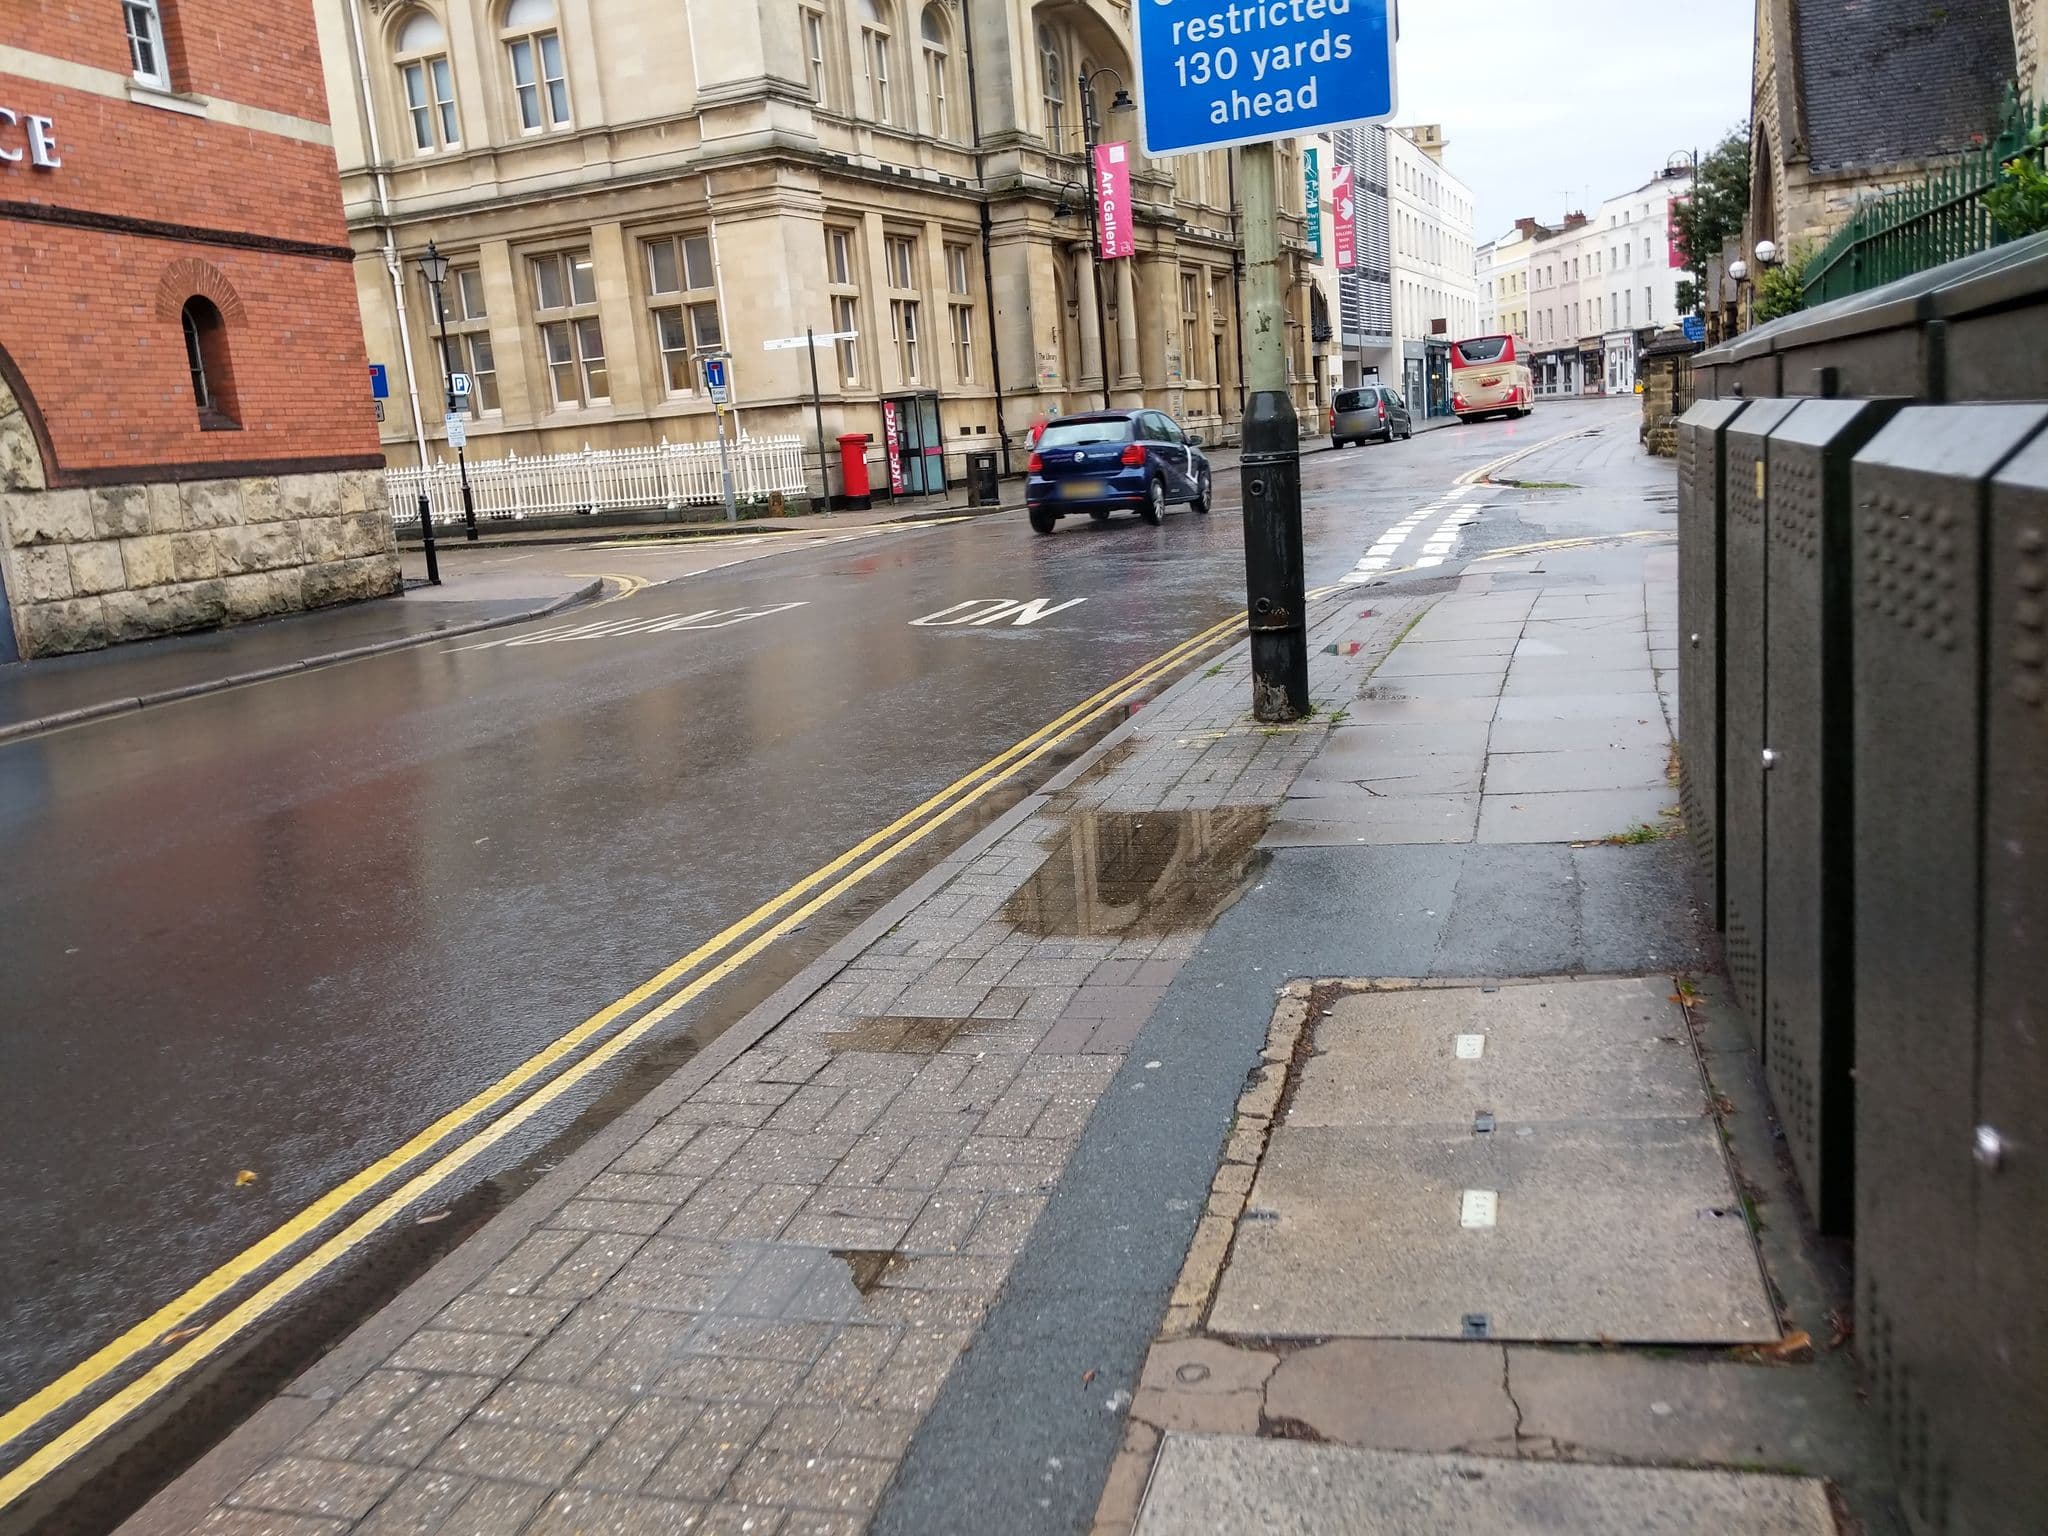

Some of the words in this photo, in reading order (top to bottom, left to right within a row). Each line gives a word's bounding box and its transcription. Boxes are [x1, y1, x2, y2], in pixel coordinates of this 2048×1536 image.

[1174, 46, 1238, 87] 130
[1250, 28, 1352, 81] yards
[1209, 75, 1318, 125] ahead
[1101, 171, 1114, 197] Art
[1103, 200, 1117, 256] Gallery
[885, 408, 897, 437] KFC
[890, 452, 902, 481] KFC
[907, 597, 1089, 626] NO
